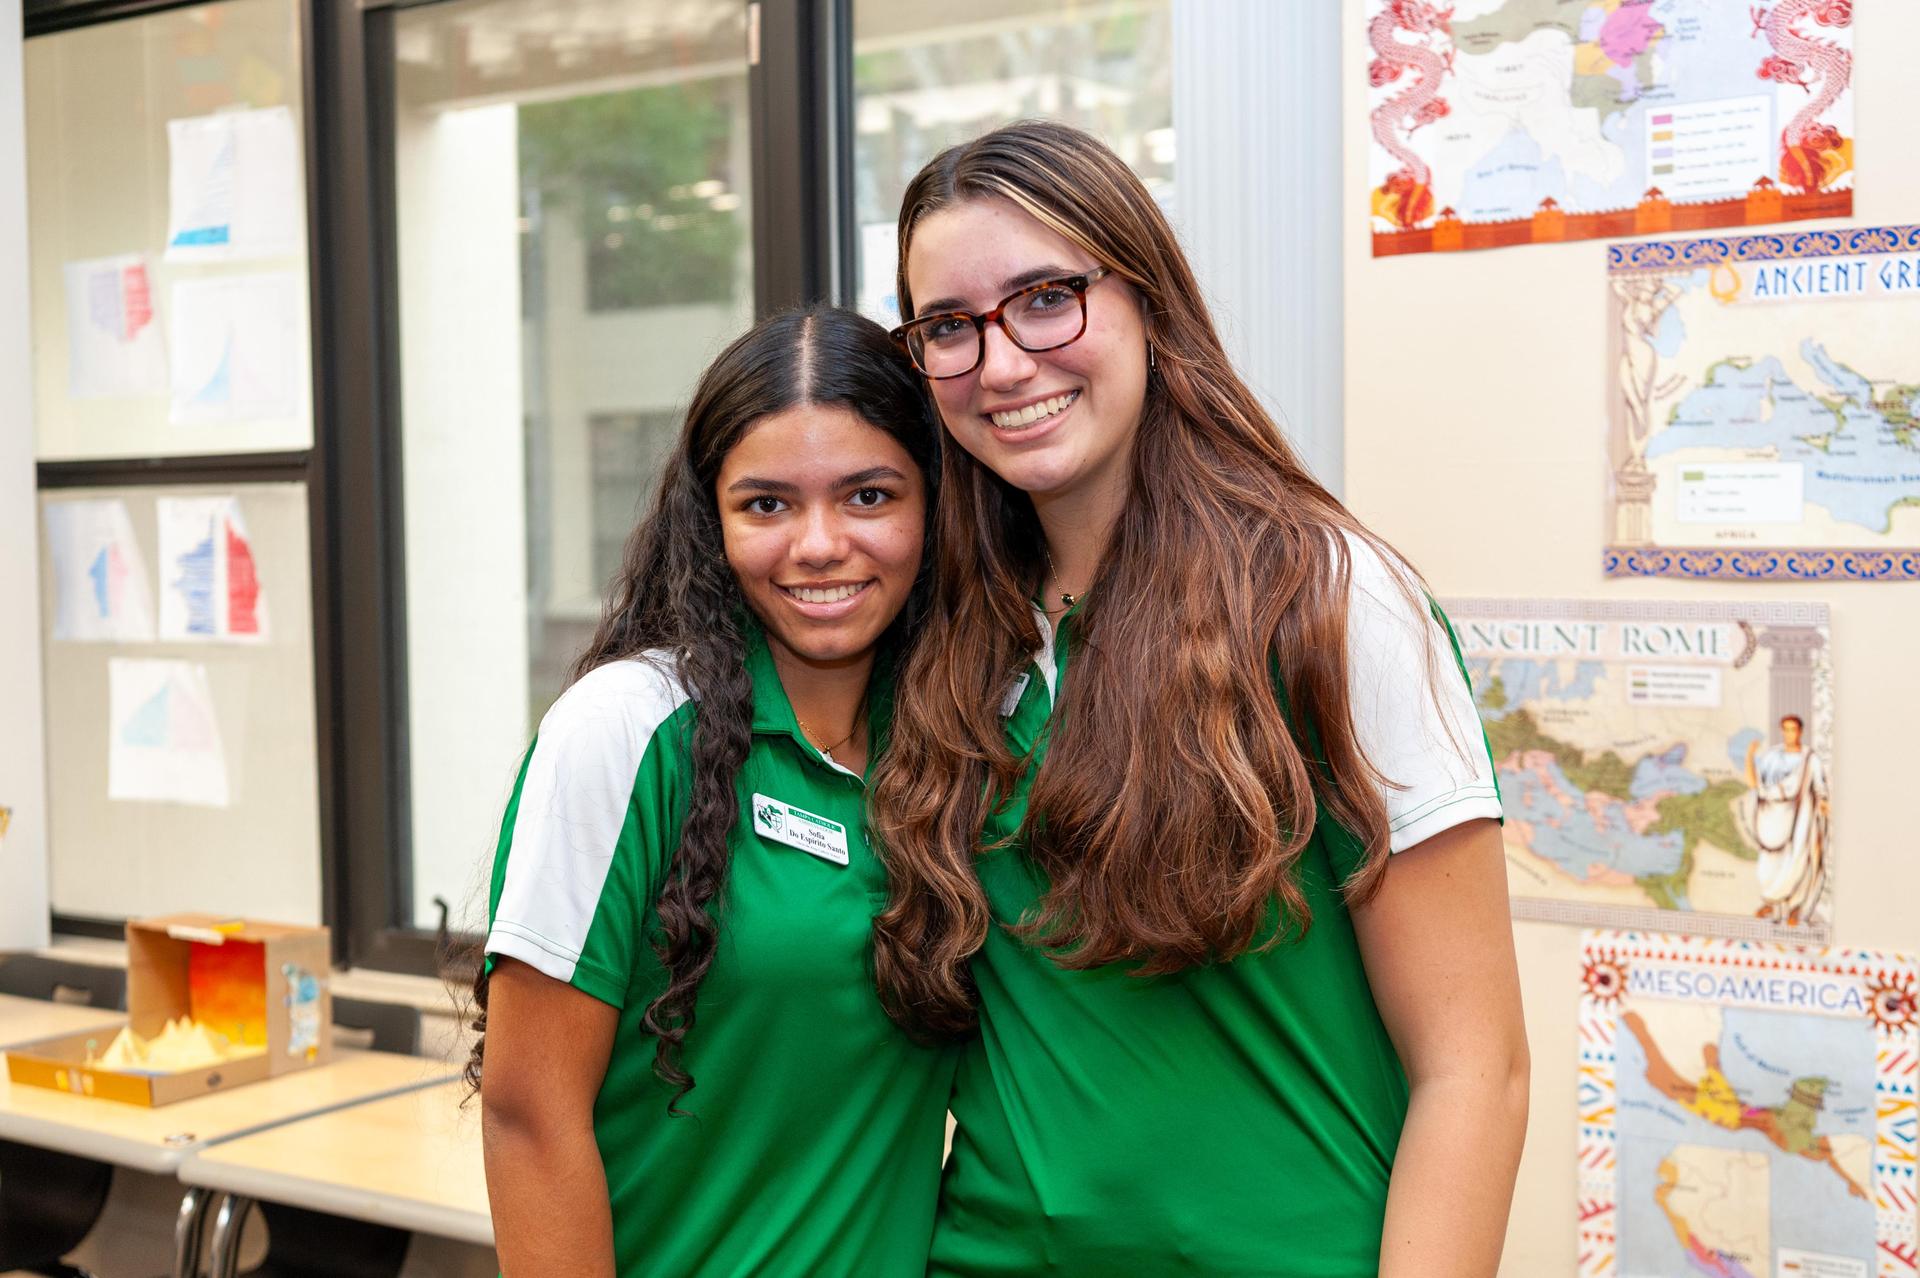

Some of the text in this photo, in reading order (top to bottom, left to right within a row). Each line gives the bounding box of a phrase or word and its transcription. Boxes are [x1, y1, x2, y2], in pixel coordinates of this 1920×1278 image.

[1754, 261, 1867, 297] ANCIENT
[1622, 625, 1731, 657] ROME
[789, 828, 799, 838] Do
[827, 843, 846, 855] Santo
[808, 828, 825, 840] Sofia
[1630, 969, 1864, 1012] MESOAMERICA
